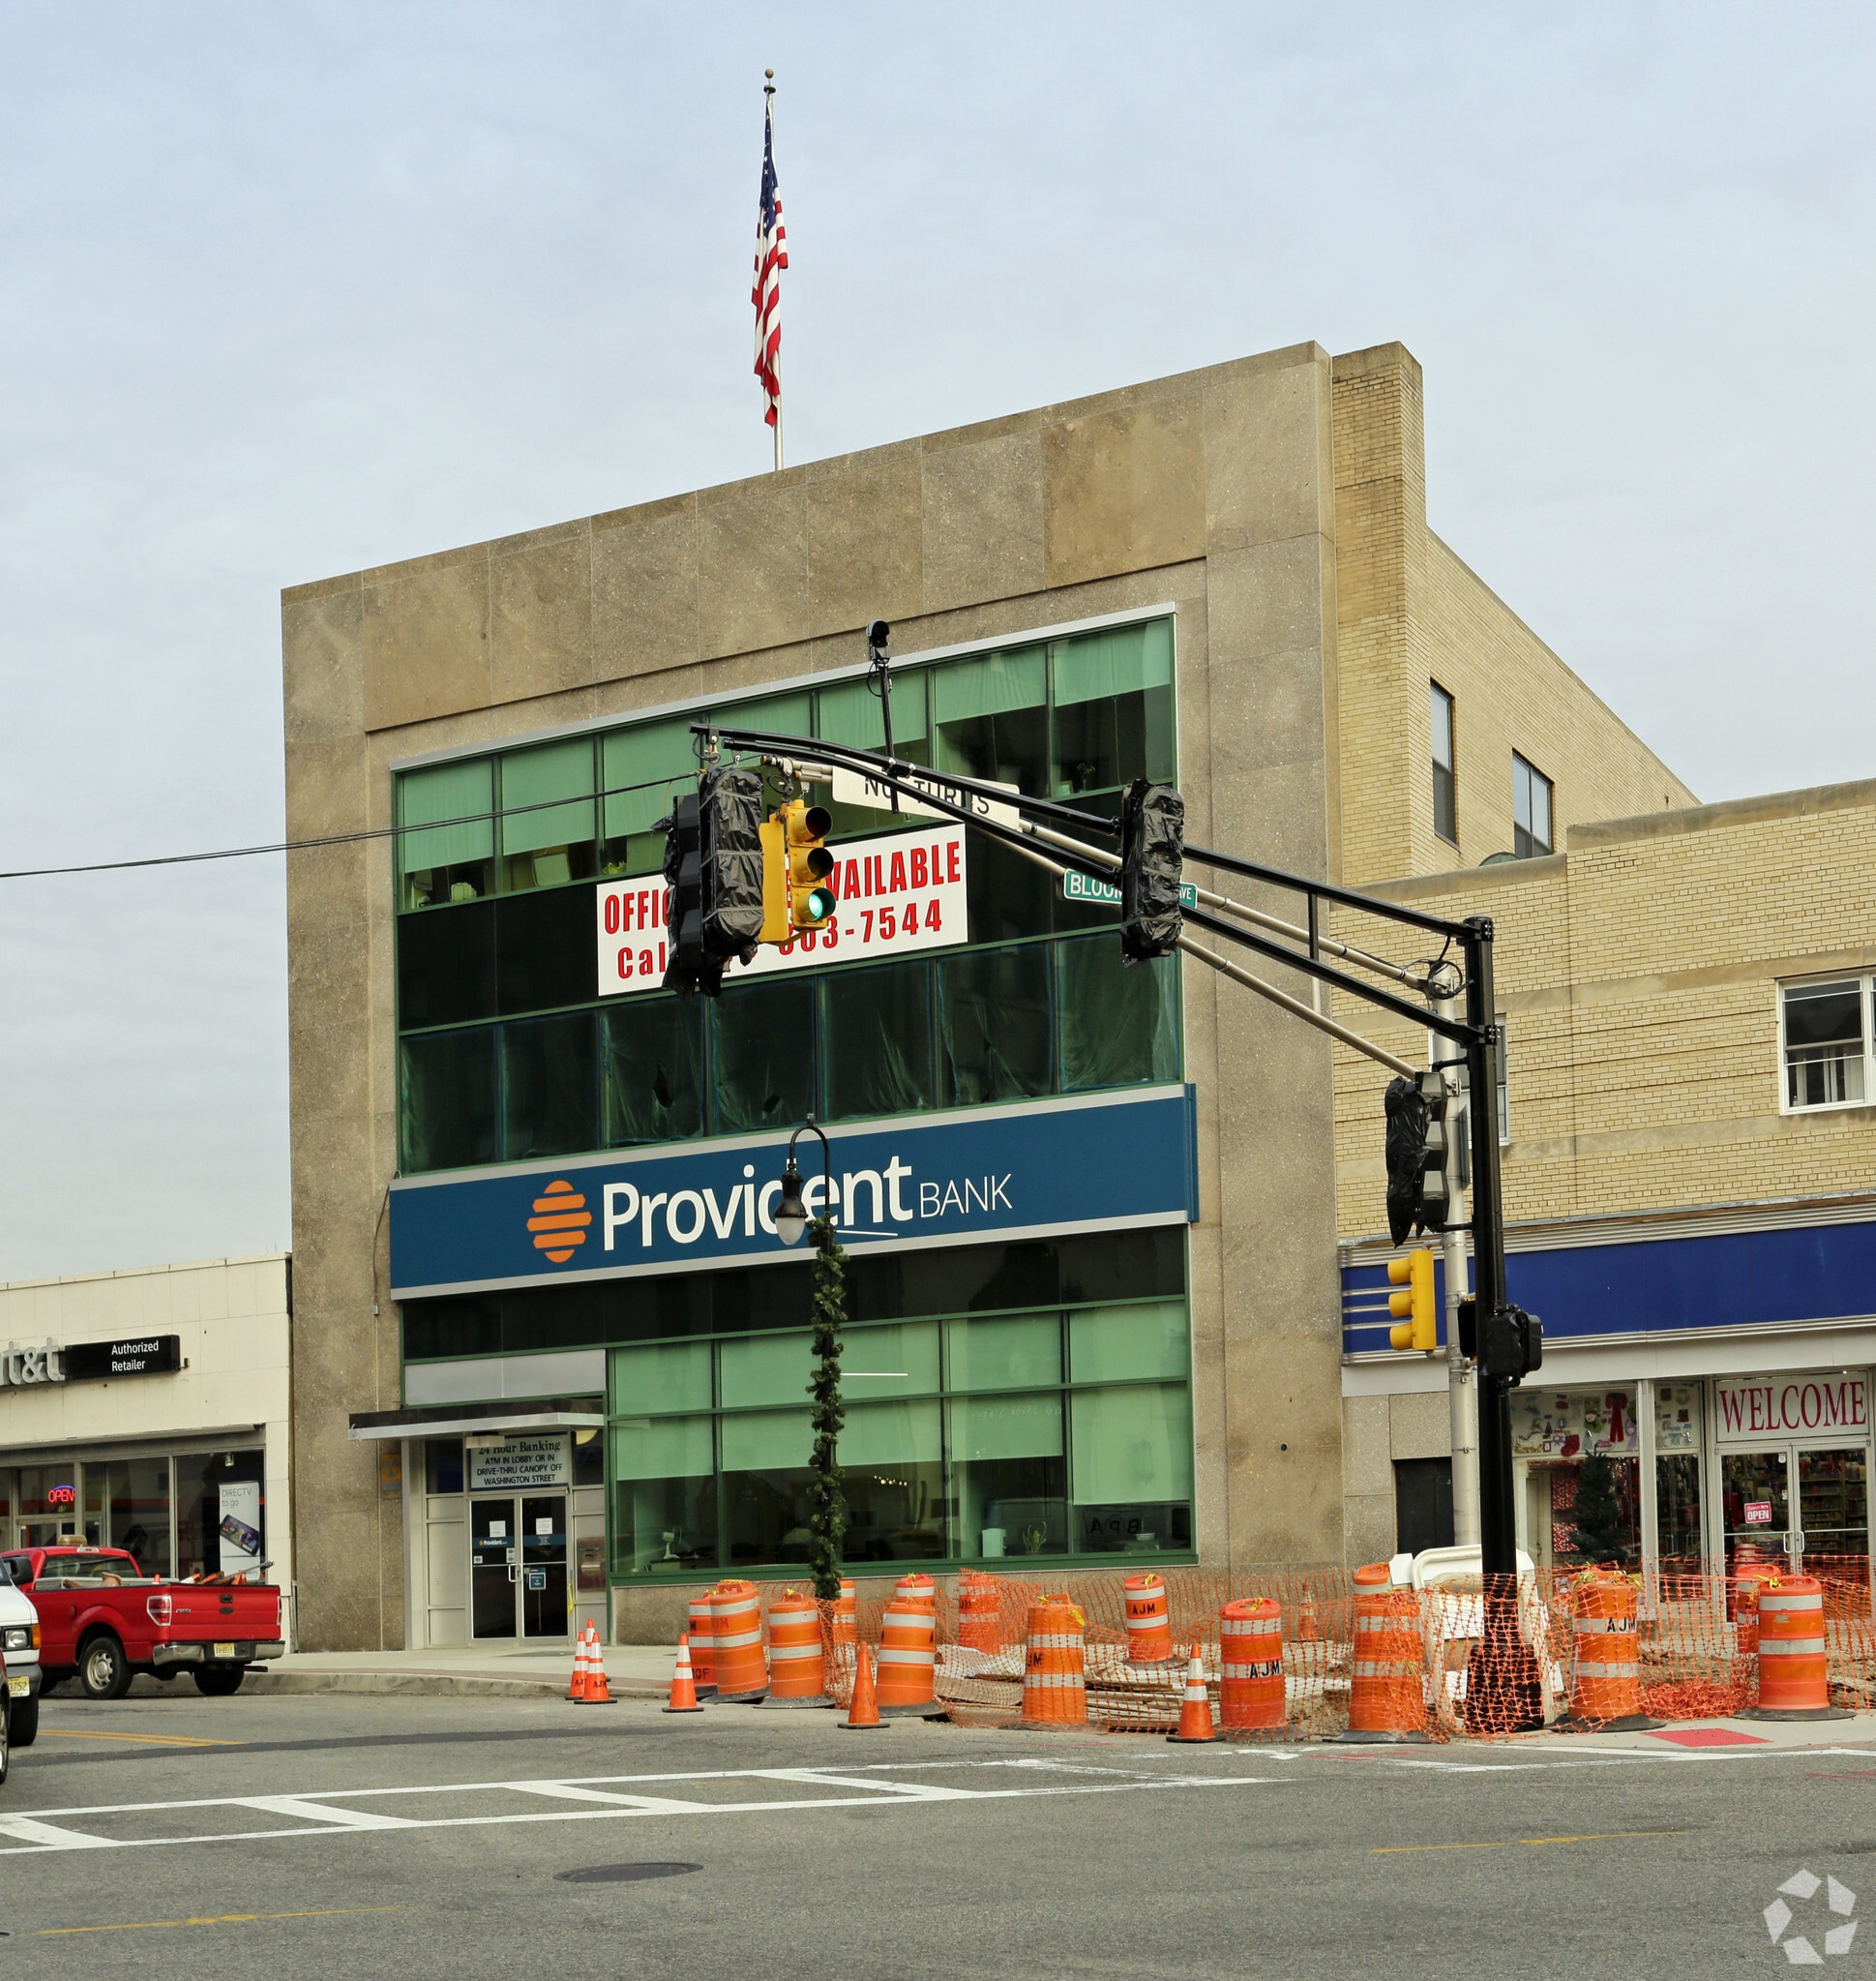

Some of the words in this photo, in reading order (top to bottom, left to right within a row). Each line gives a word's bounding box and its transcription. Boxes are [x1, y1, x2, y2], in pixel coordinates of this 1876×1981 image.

[913, 780, 990, 815] TURS
[825, 840, 961, 902] VAILABLE
[919, 1173, 1013, 1218] BANK
[110, 1339, 160, 1356] Authorized
[0, 1336, 65, 1386] t&t
[110, 1360, 146, 1372] Retailer
[1718, 1381, 1867, 1433] WELCOME
[519, 1439, 560, 1453] Banking
[485, 1456, 501, 1465] ATM
[503, 1456, 510, 1464] IN
[511, 1455, 533, 1463] LOBBY
[535, 1454, 546, 1462] OR
[476, 1465, 518, 1476] DRIVE-THRU
[519, 1463, 548, 1474] CANOPY
[551, 1463, 563, 1472] OFF
[484, 1475, 530, 1486] WASHINGTON
[532, 1473, 555, 1483] STREET
[47, 1489, 74, 1503] OPEN
[222, 1487, 252, 1498] DIRECTV
[230, 1499, 239, 1508] go
[1747, 1510, 1770, 1521] OPEN
[1132, 1603, 1156, 1615] AJM
[1249, 1659, 1281, 1680] AJM
